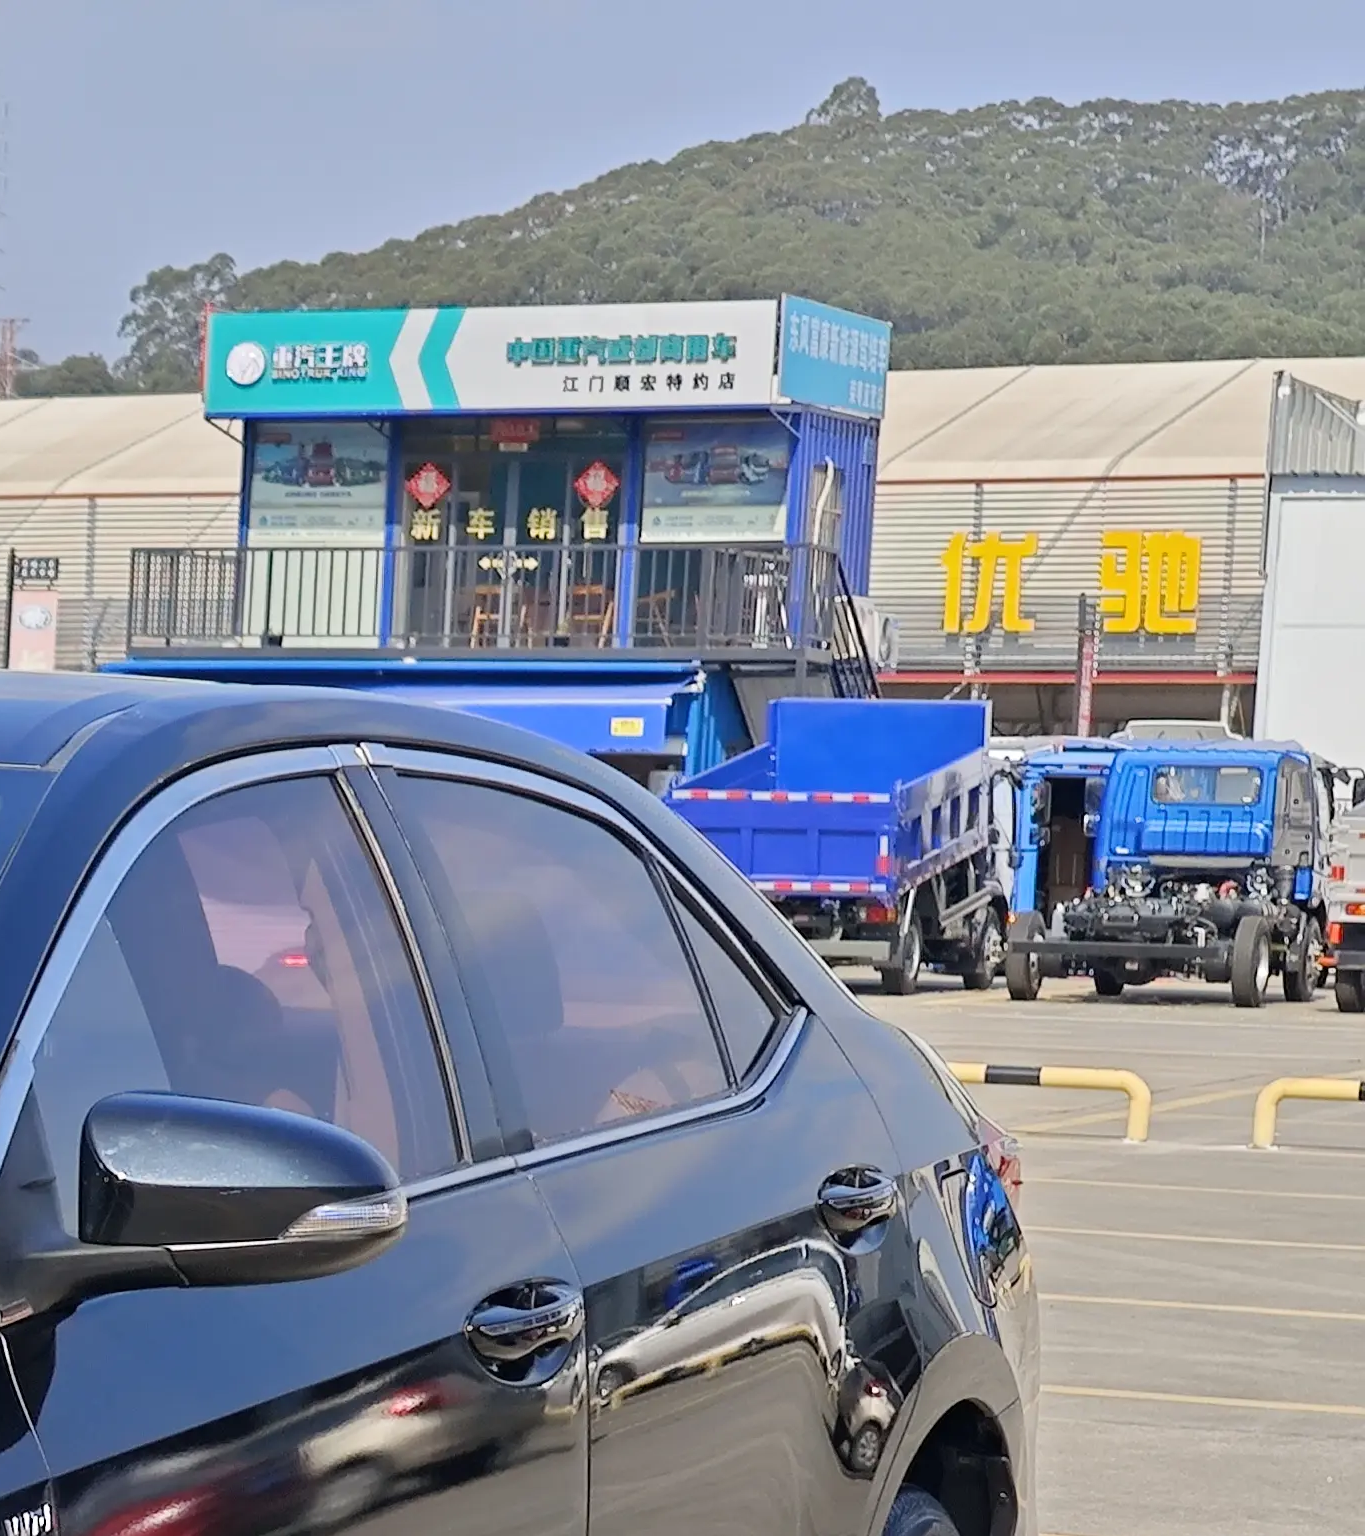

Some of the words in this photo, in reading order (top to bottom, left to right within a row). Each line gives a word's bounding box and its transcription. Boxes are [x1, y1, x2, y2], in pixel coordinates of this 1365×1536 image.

[562, 372, 736, 393] 江门顺宏特约店
[410, 507, 609, 541] 新车销售
[938, 530, 1202, 633] 优驰
